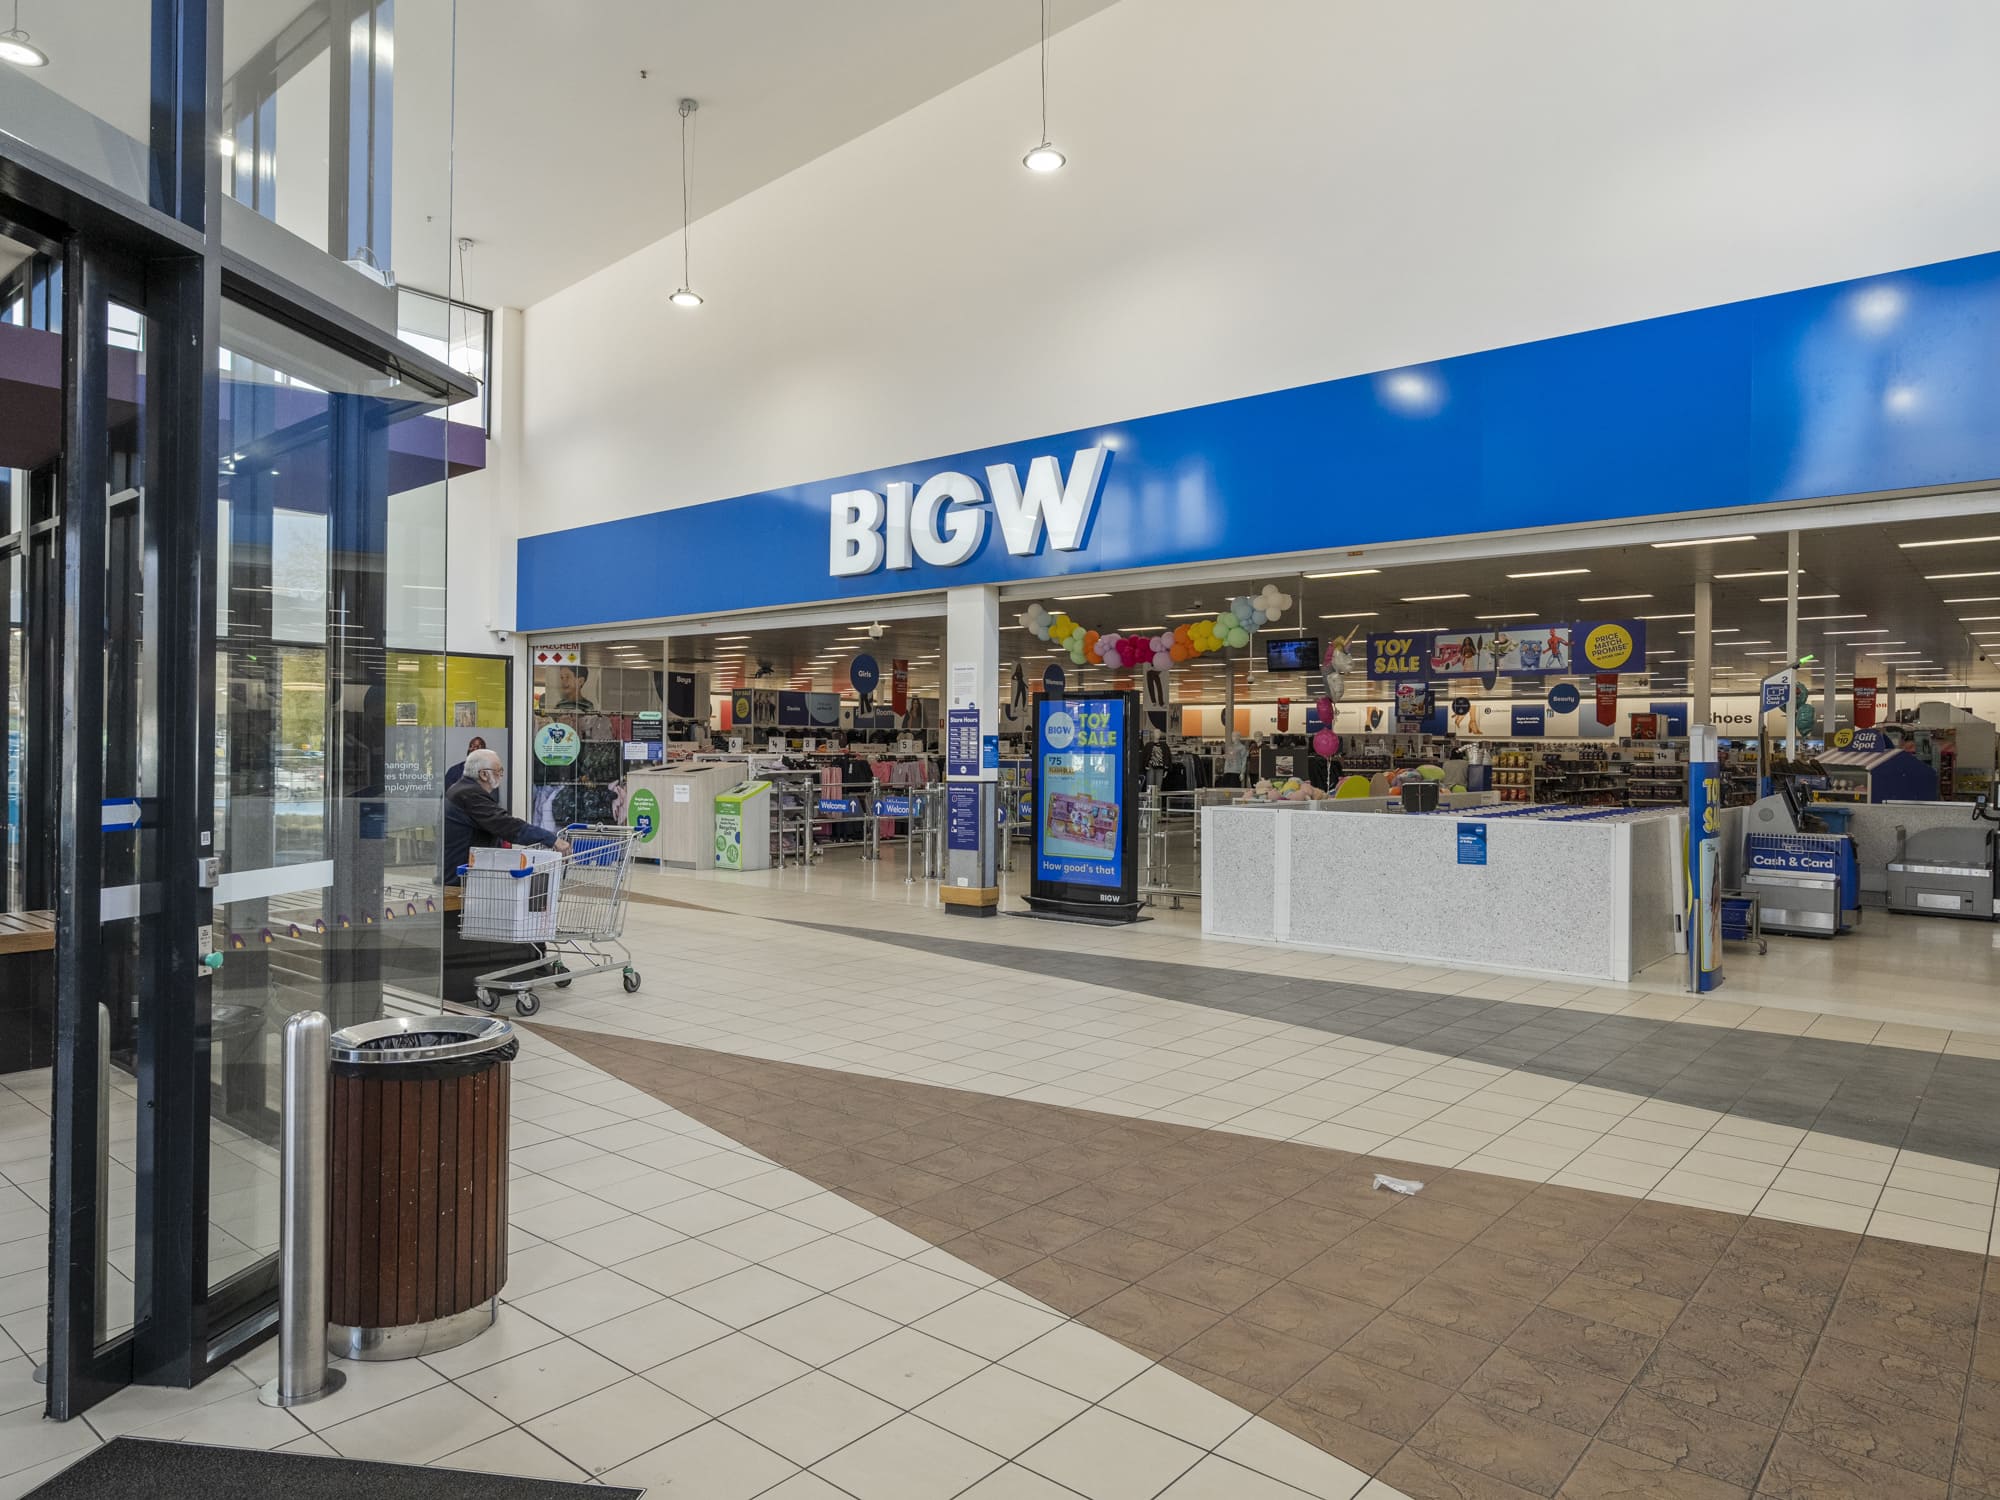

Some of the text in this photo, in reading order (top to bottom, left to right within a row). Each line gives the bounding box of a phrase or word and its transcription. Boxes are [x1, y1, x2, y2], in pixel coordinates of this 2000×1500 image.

[1595, 632, 1619, 643] PRICE
[1375, 638, 1413, 656] TOY
[1594, 638, 1622, 650] MATCH
[1592, 644, 1628, 656] PROMISE
[1374, 656, 1420, 673] SALE
[858, 670, 871, 678] Girls
[1781, 675, 1788, 683] 2
[1079, 713, 1111, 729] TOY
[1078, 730, 1117, 747] SALE
[1858, 732, 1877, 741] Gift
[902, 741, 907, 749] 5
[1852, 740, 1875, 750] Spot
[385, 761, 420, 771] hanging
[399, 771, 433, 781] through
[385, 782, 433, 793] mployment
[820, 801, 847, 810] Welcome
[1753, 855, 1833, 868] Cash & Card
[1043, 861, 1115, 875] How good's that
